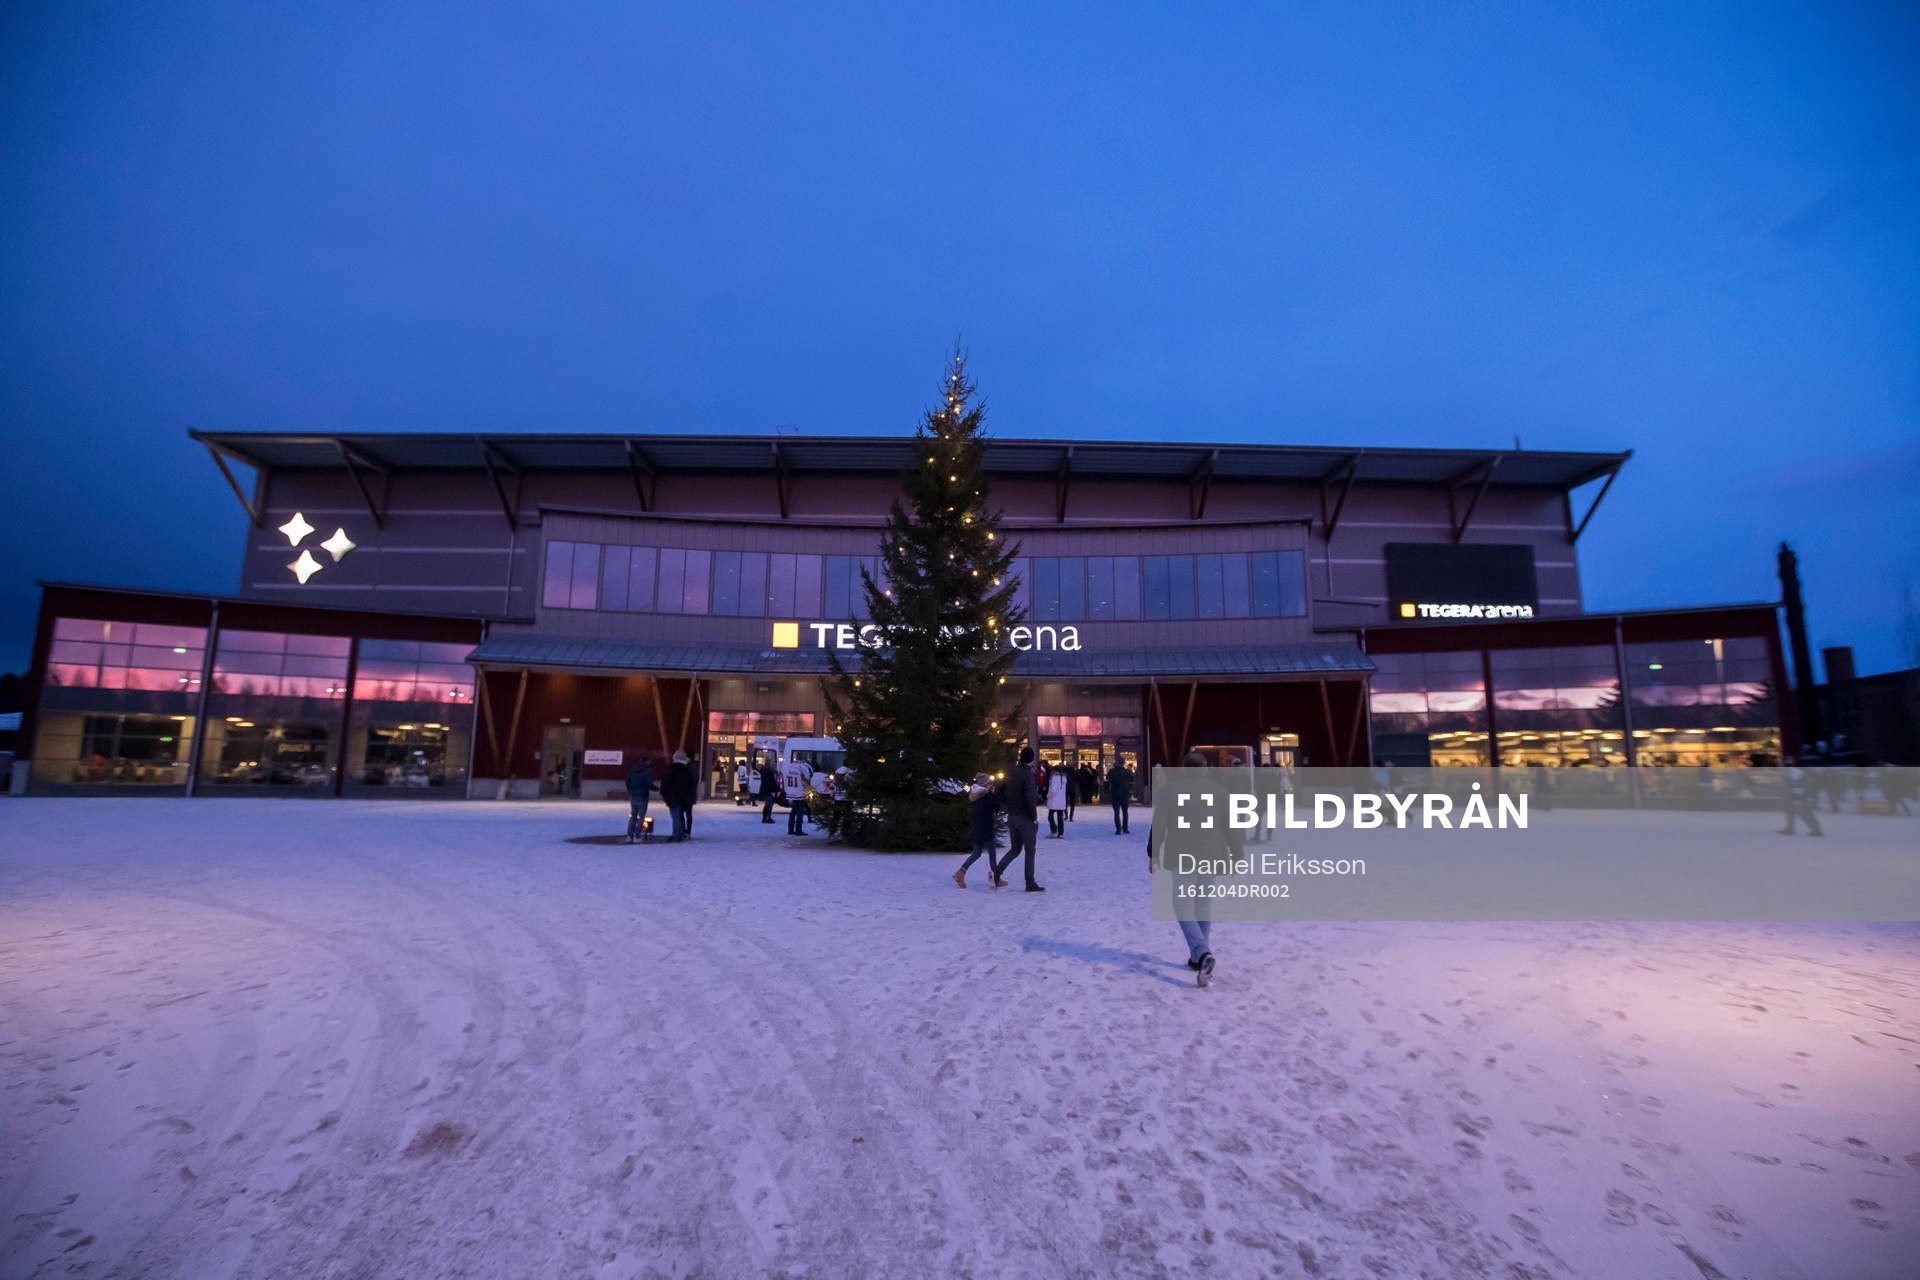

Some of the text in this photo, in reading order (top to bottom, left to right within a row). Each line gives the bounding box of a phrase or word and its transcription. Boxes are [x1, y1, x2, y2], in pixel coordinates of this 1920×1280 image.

[1418, 604, 1534, 619] TEGERA arena
[810, 624, 954, 649] TEG
